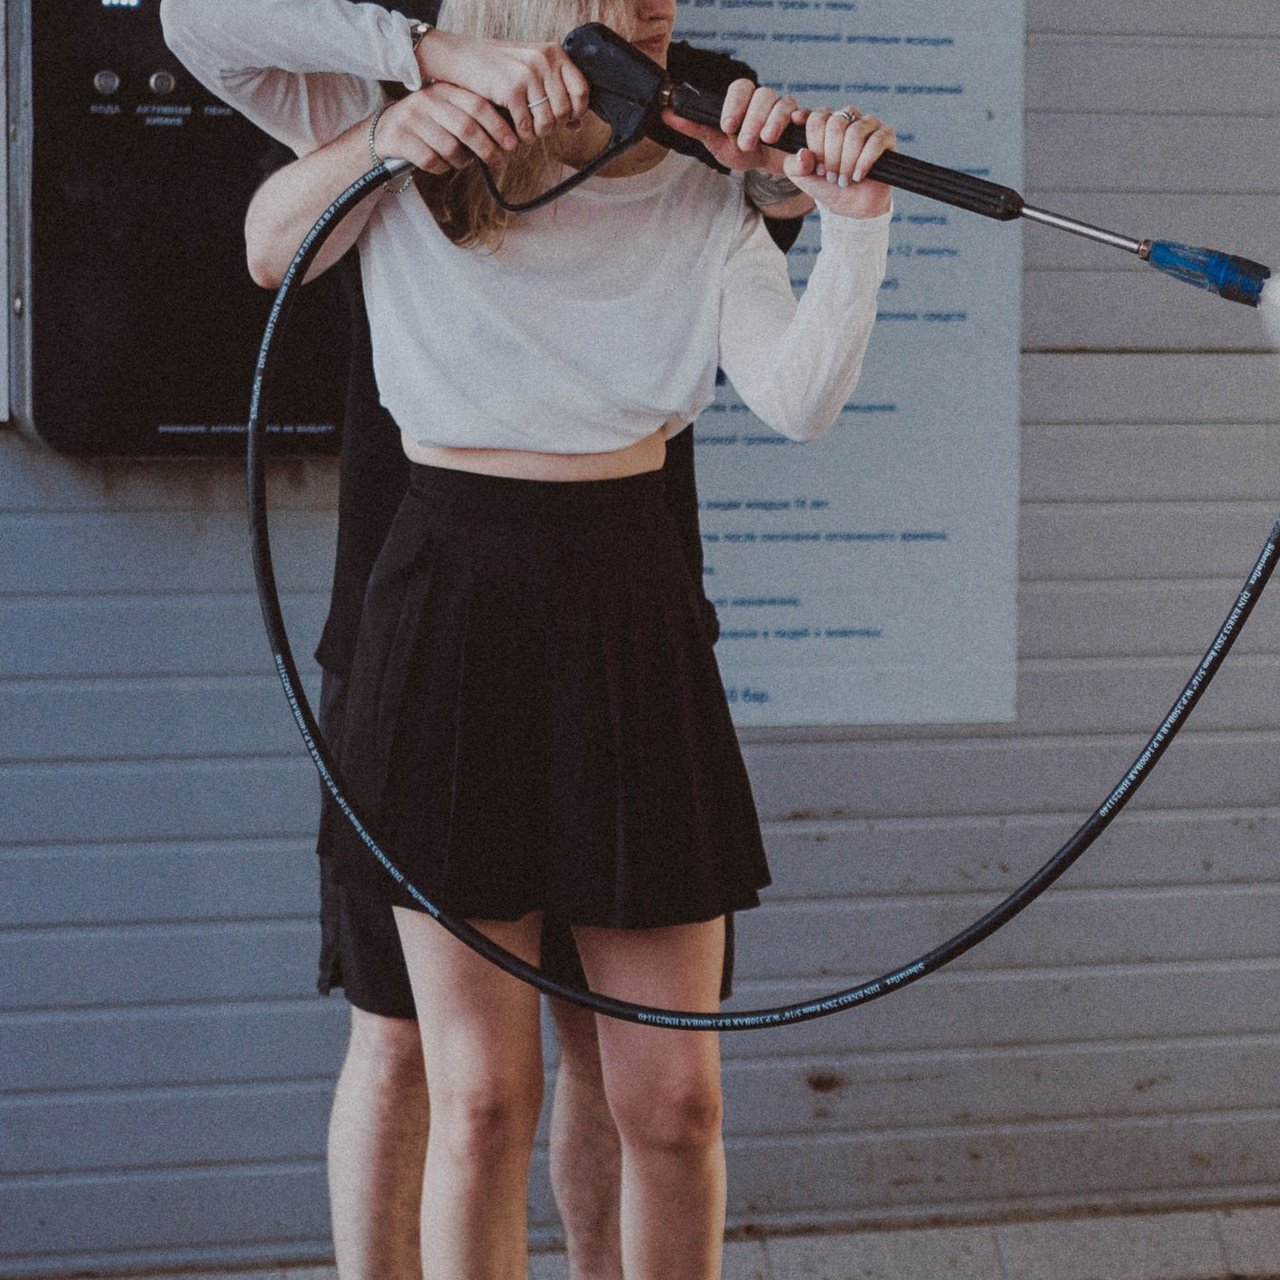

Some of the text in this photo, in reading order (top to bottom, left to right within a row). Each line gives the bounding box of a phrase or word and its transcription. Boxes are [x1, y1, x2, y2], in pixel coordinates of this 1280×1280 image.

[1098, 541, 1275, 818] Siberiaflex DIN EN853 2SN 8mm 5/16" W.P.350BAR B.P.1400BAR HM251140
